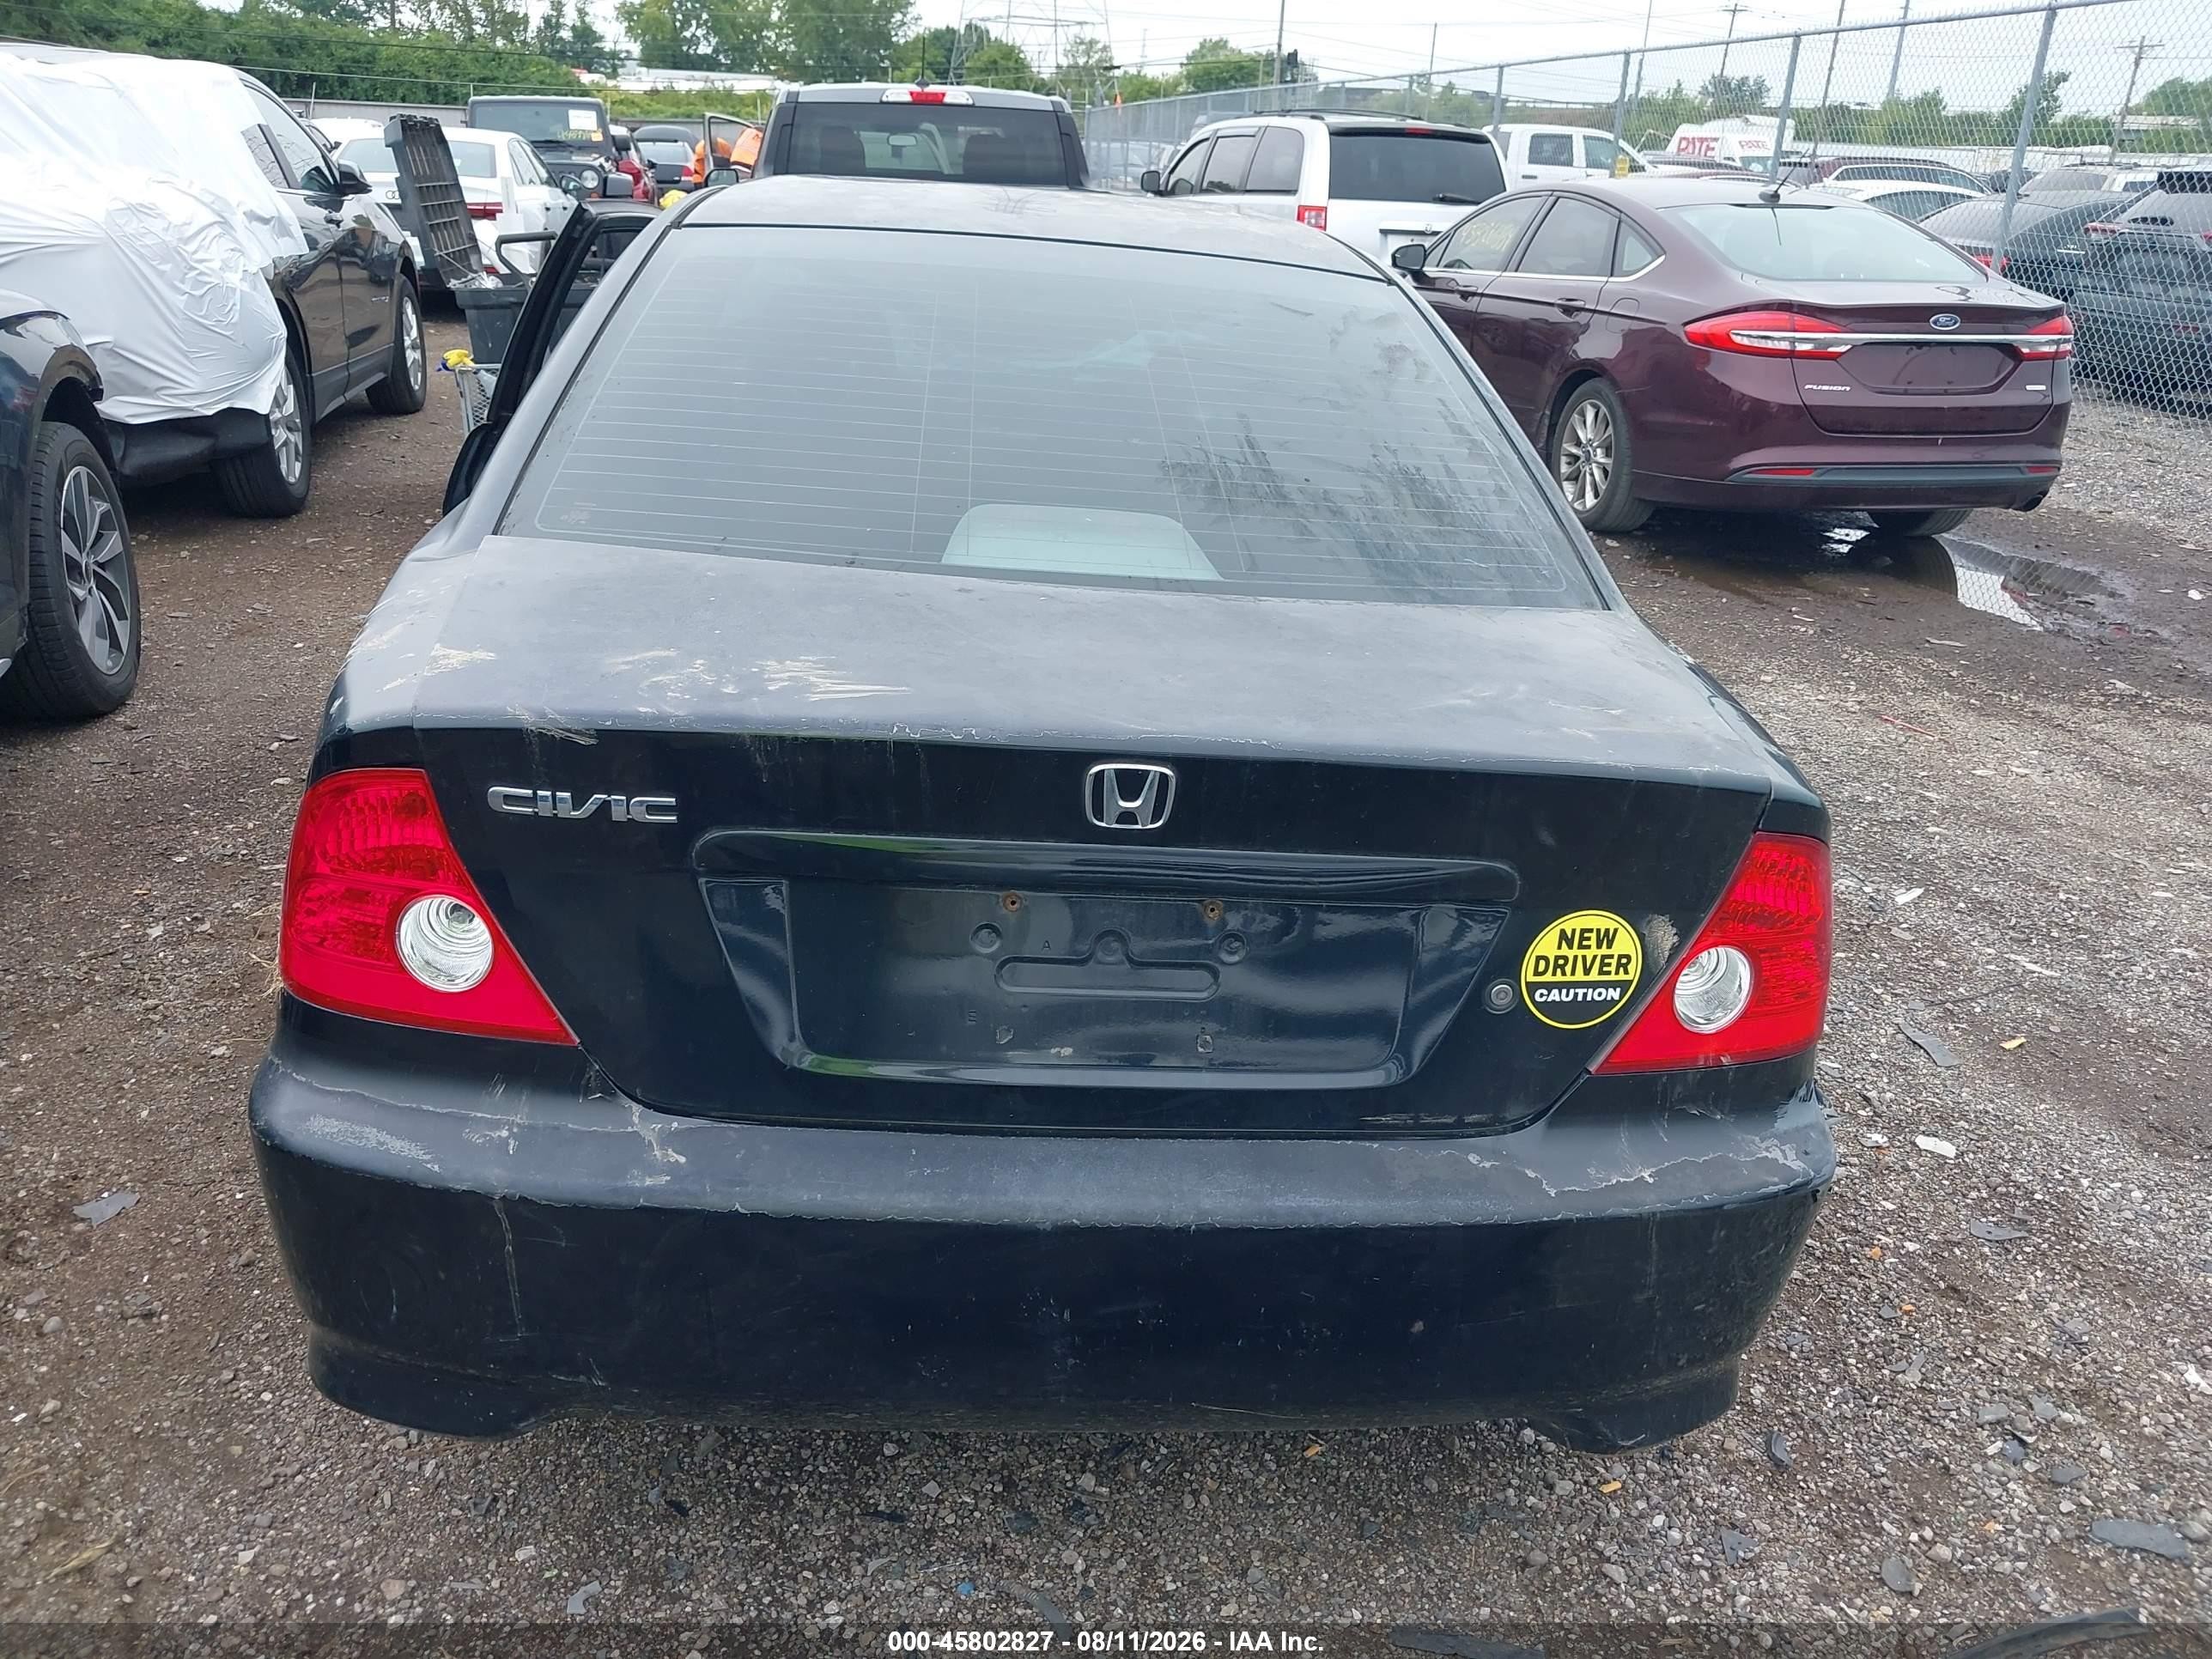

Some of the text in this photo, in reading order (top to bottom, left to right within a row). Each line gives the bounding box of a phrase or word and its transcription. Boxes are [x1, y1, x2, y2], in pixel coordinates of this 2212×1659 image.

[487, 786, 678, 823] CIVIC
[1556, 927, 1620, 951] NEW
[1531, 953, 1632, 977] DRIVER
[1534, 988, 1621, 1002] CAUTION
